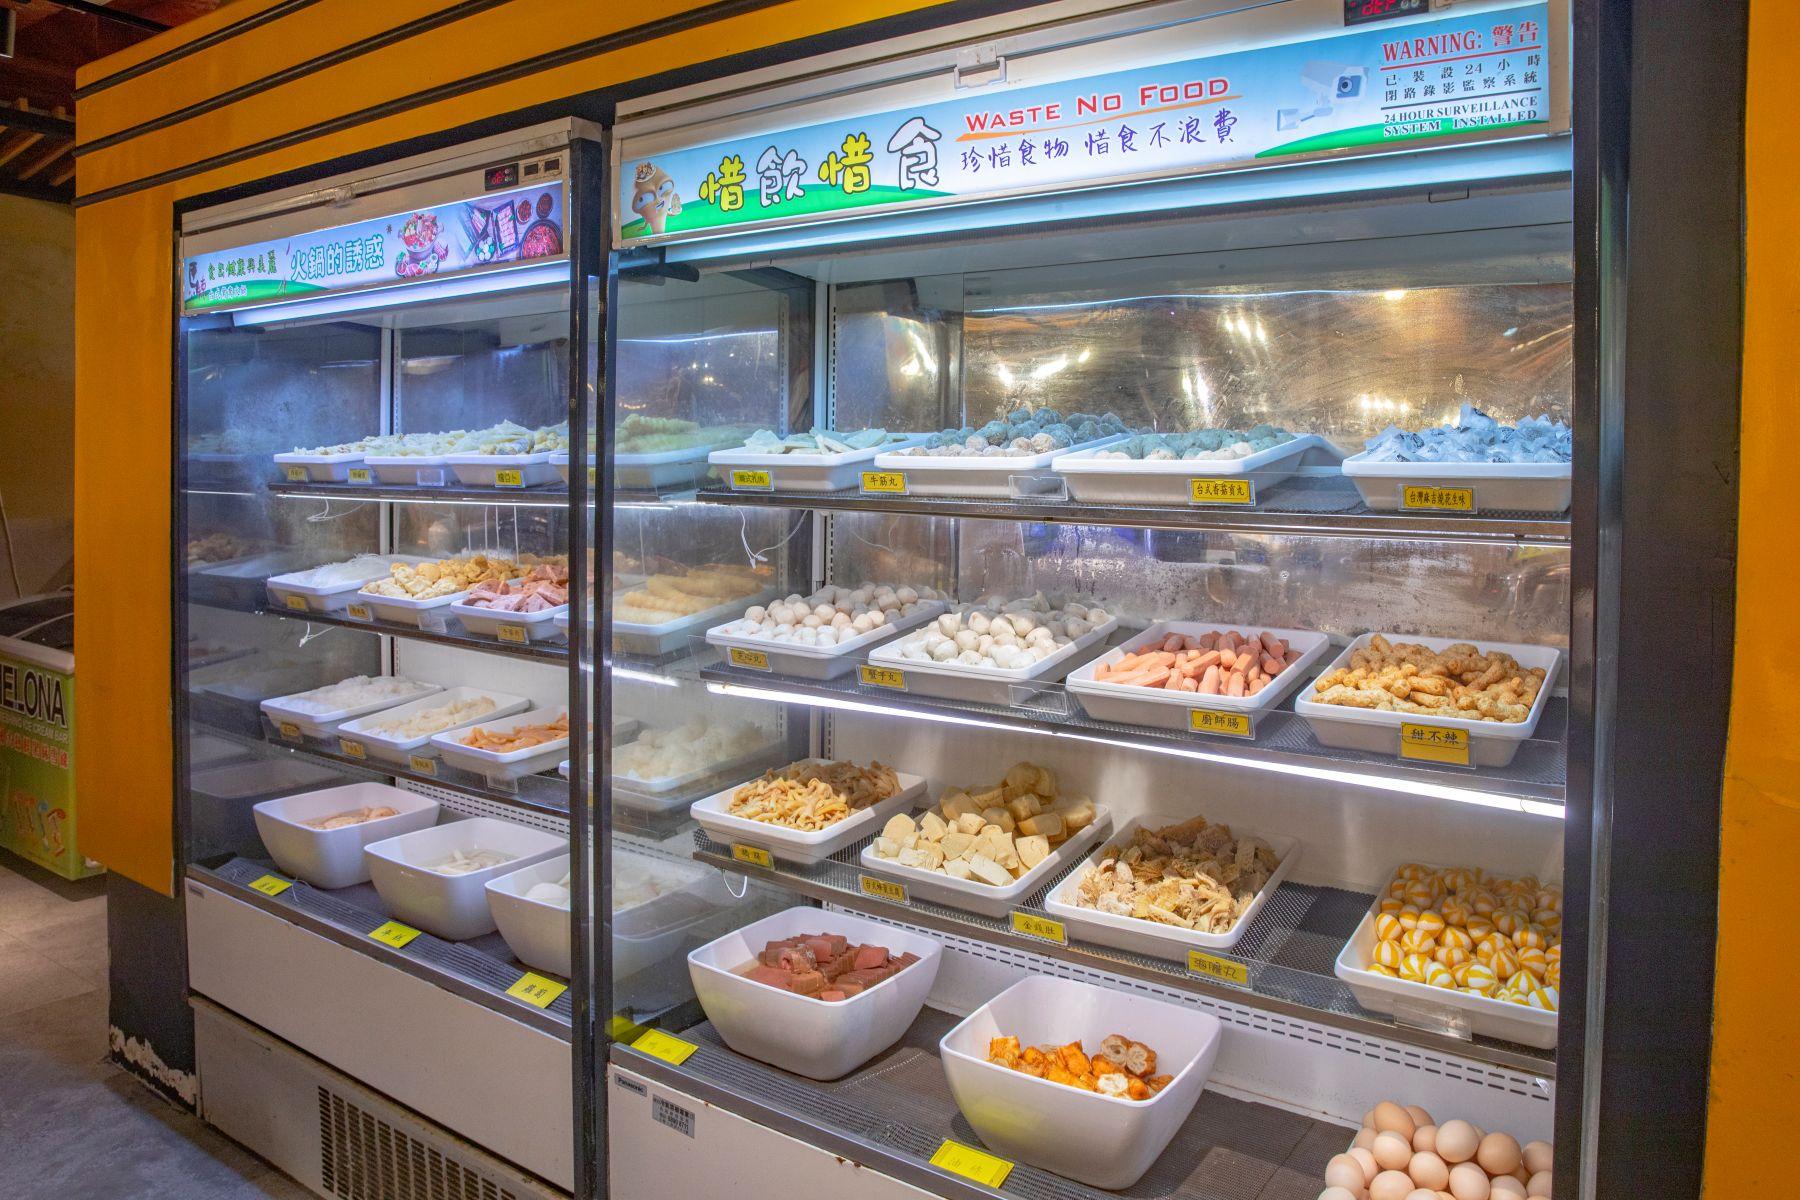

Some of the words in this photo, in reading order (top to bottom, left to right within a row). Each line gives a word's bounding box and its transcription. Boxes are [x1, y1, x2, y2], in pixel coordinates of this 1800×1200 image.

[1382, 31, 1483, 62] WARNING:
[1492, 21, 1539, 47] 警告
[966, 103, 1061, 133] WASTE
[1076, 94, 1122, 116] NO
[1140, 78, 1229, 107] FOOD
[1384, 114, 1396, 124] 24
[1399, 109, 1434, 122] HOUR
[1437, 96, 1538, 117] SURVEILLANCE
[961, 137, 1070, 173] 珍惜食物
[1084, 107, 1239, 157] 惜食不浪費
[1384, 120, 1441, 137] SYSTEM
[1453, 109, 1537, 129] INSTALLED
[290, 235, 385, 282] 火鍋的誘惑
[870, 475, 898, 487] 牛筋丸
[0, 664, 67, 728] ELONA
[1201, 714, 1240, 729] 廚師腸
[1411, 728, 1459, 745] 甜不辣
